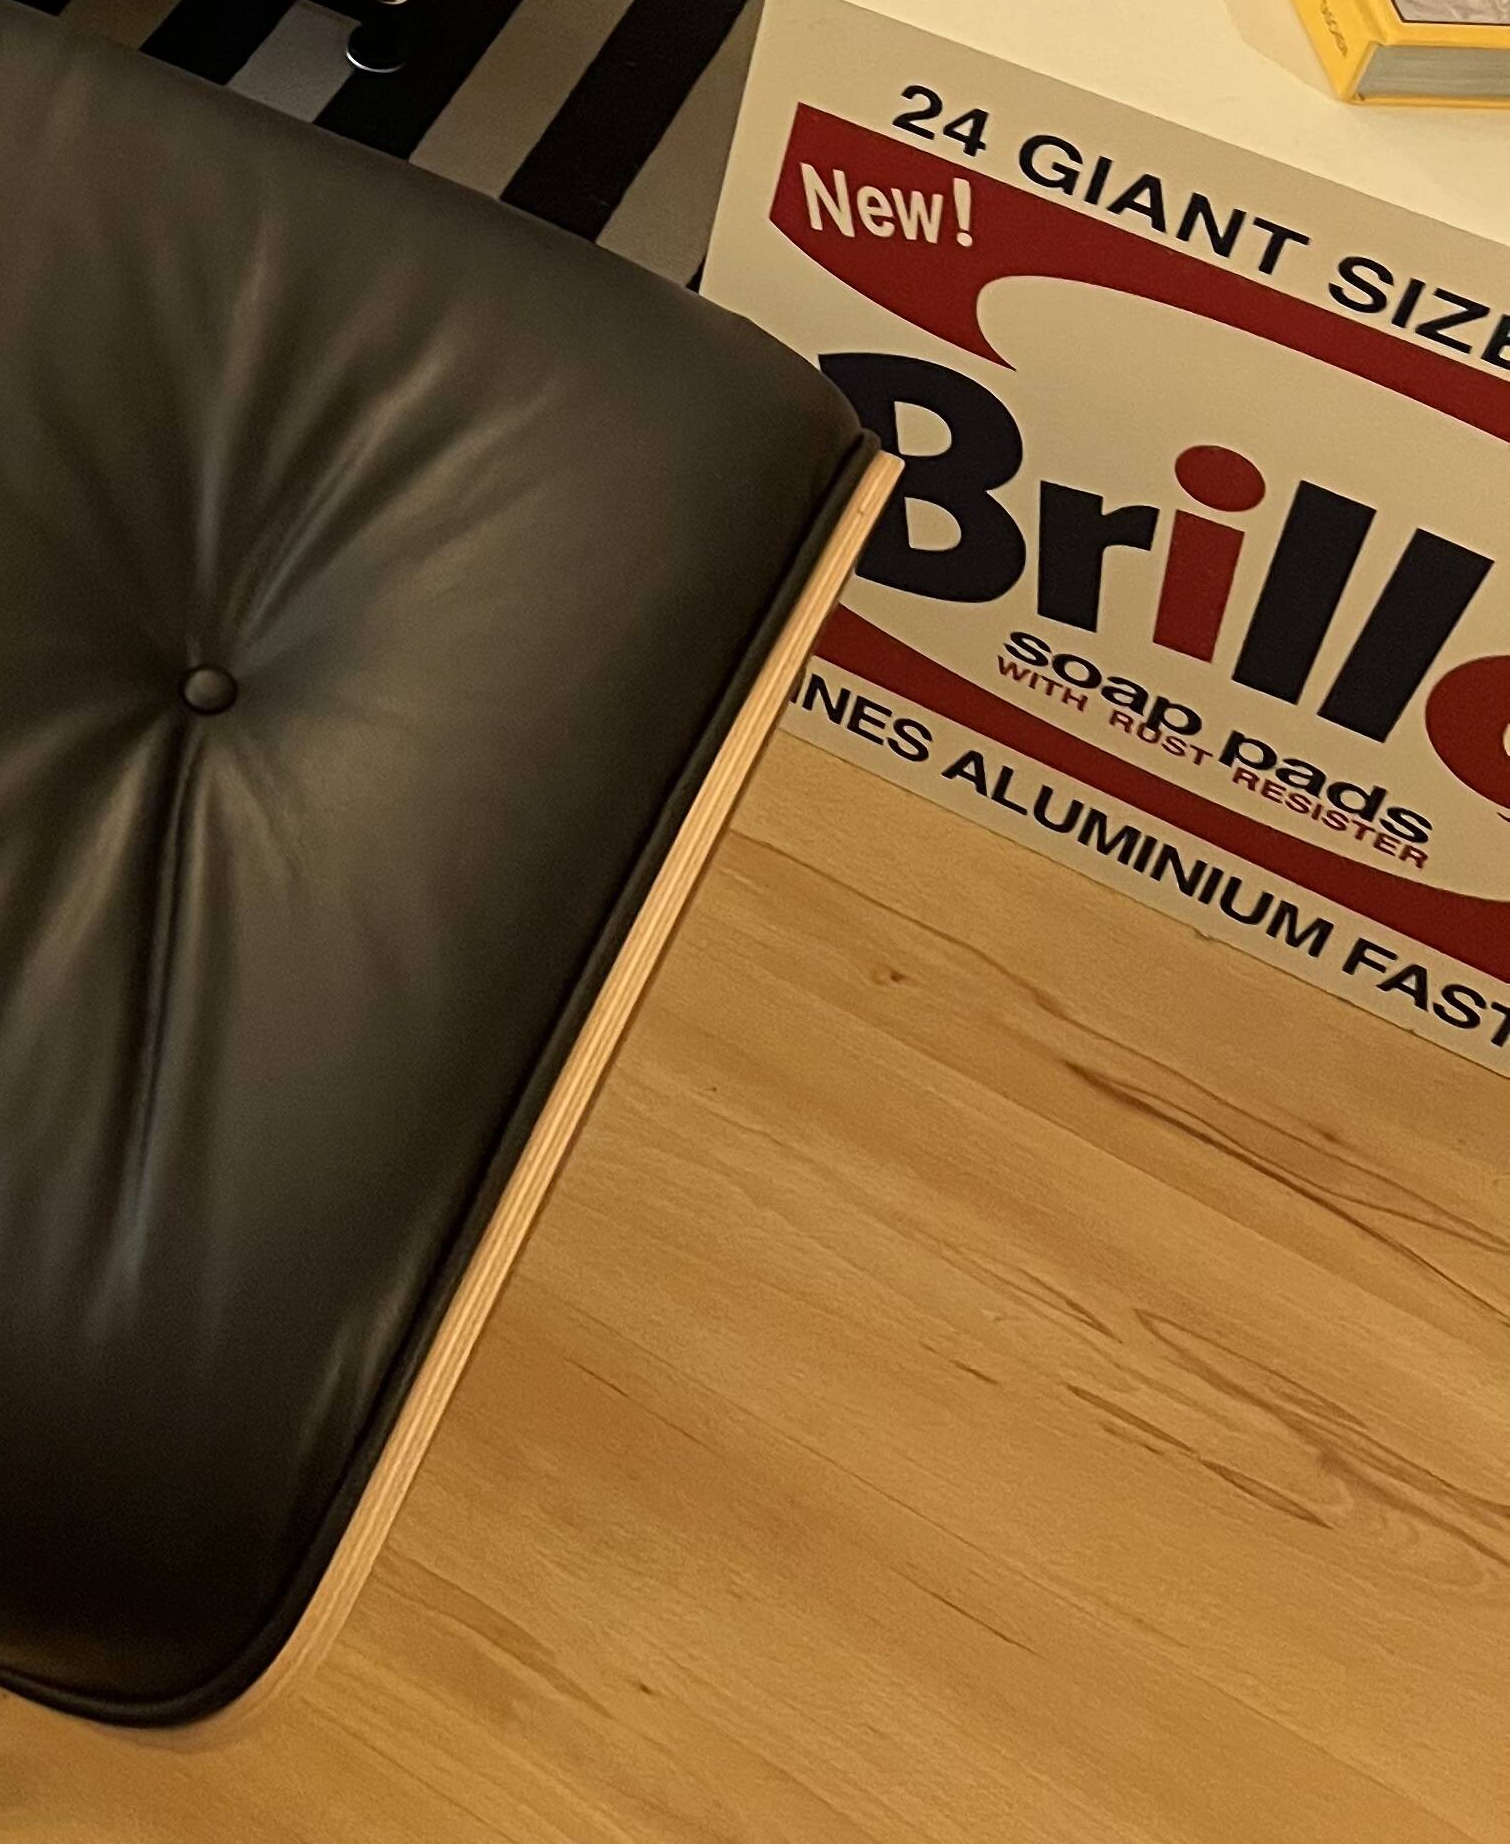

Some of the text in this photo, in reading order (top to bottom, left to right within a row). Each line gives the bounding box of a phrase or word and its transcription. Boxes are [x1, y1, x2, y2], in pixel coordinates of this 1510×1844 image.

[799, 162, 974, 248] New!
[891, 84, 990, 157] 24
[1018, 134, 1310, 276] GIANT
[996, 654, 1429, 869] WITH RUST RESISTER
[1003, 631, 1433, 845] soap pads
[940, 749, 1335, 958] ALUMINIUM
[1341, 936, 1510, 1048] FAST
